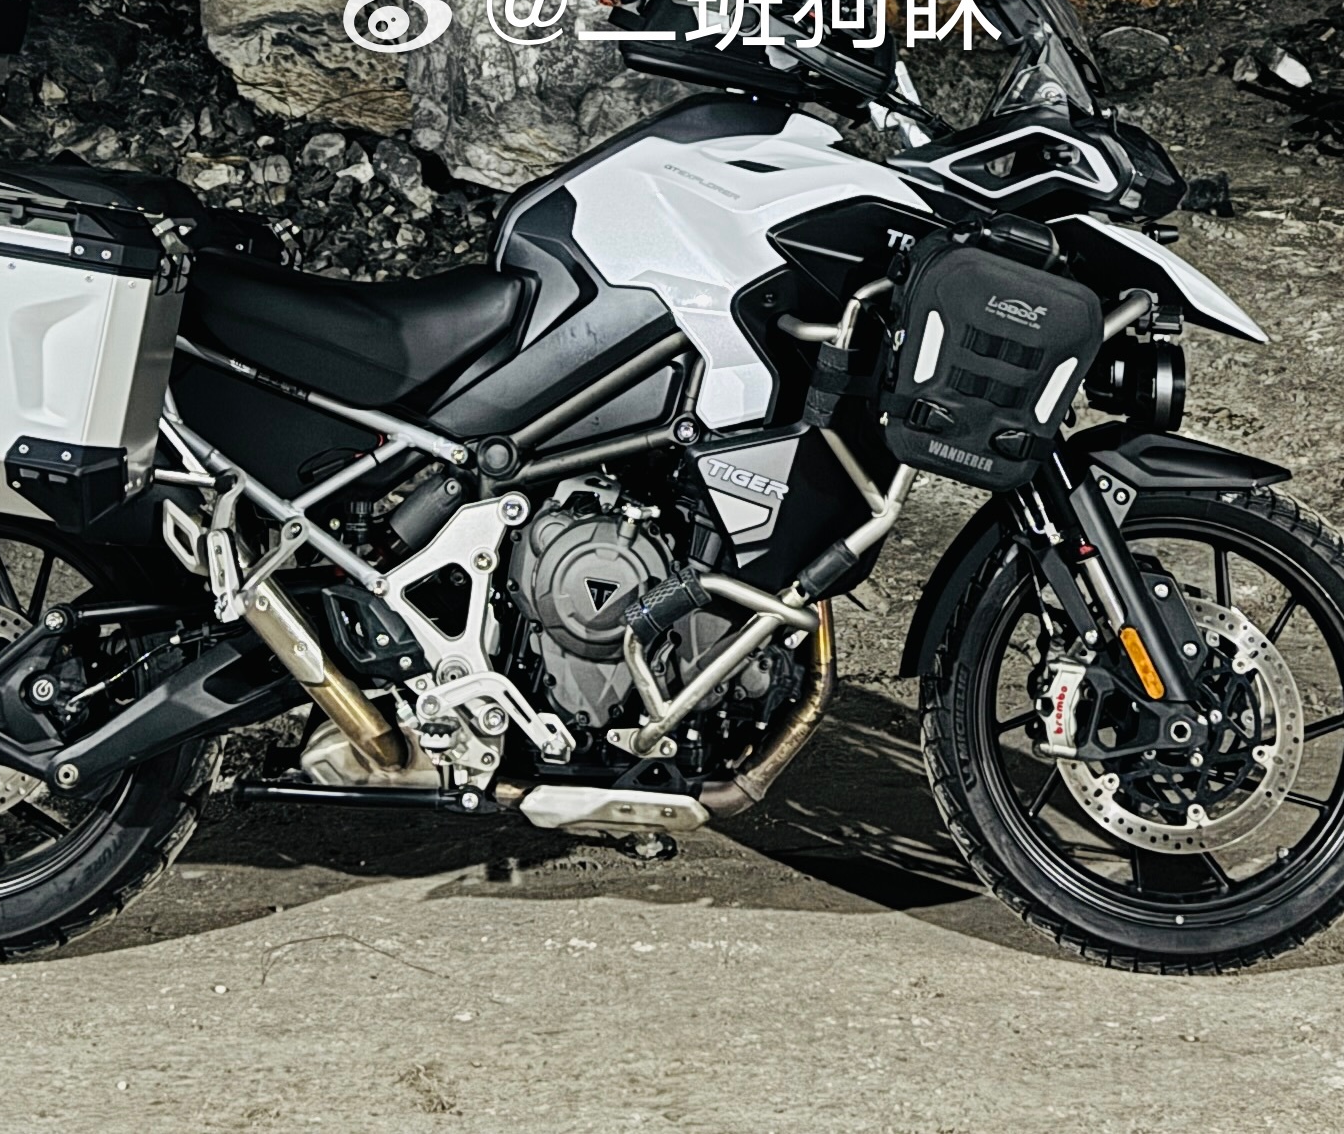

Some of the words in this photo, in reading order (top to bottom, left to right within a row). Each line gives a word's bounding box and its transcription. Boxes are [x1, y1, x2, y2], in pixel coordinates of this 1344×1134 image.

[928, 439, 994, 472] WANDERER
[706, 458, 790, 501] TIGER
[1053, 685, 1068, 735] brembo
